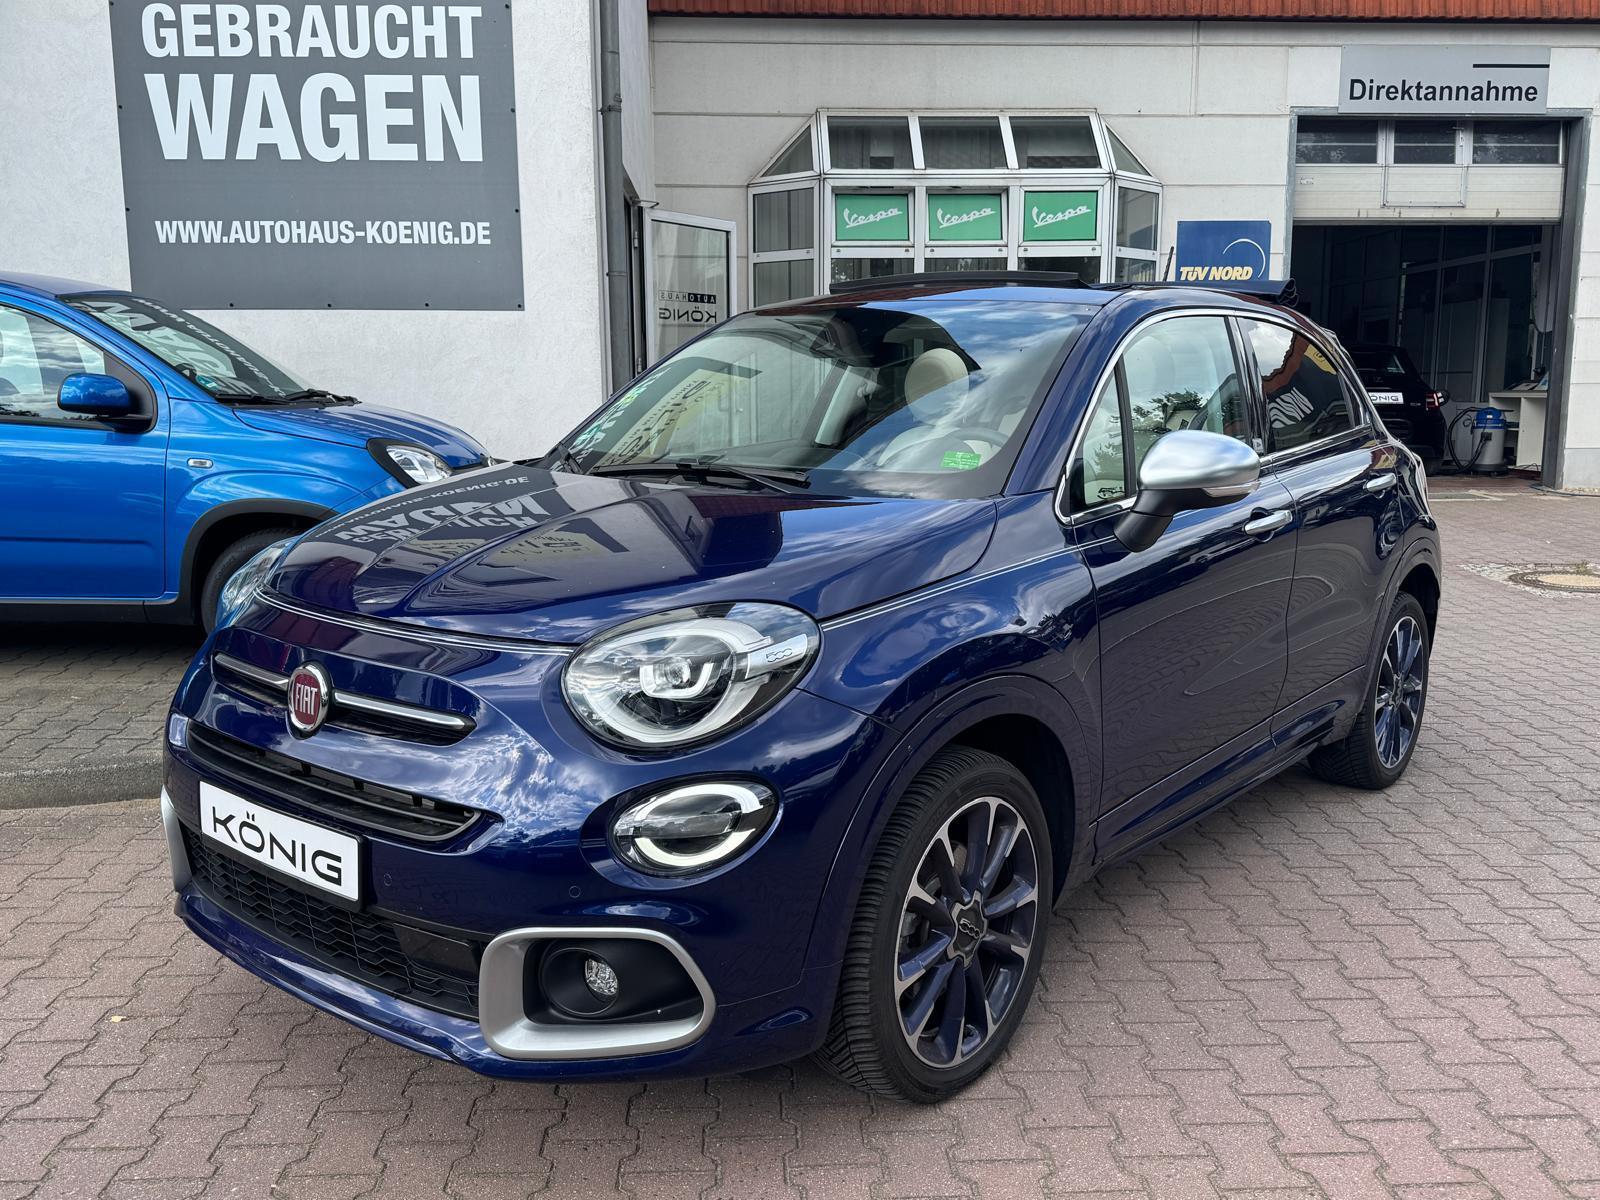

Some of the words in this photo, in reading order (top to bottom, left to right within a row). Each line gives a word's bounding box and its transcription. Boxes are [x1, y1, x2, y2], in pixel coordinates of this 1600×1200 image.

[141, 3, 482, 60] GEBRAUCHT
[1348, 78, 1538, 103] Direktannahme
[143, 72, 484, 163] WAGEN
[843, 207, 903, 229] Vespa
[936, 207, 996, 229] Vespa
[1031, 205, 1092, 228] Vespa
[155, 220, 491, 245] WWW.AUTOHAUS-KOENIG.DE
[1180, 266, 1210, 281] TÜV
[1208, 266, 1253, 281] NORD
[1370, 393, 1400, 402] ÖNIG
[295, 683, 318, 716] FIAT
[212, 805, 342, 887] KÖNIG
